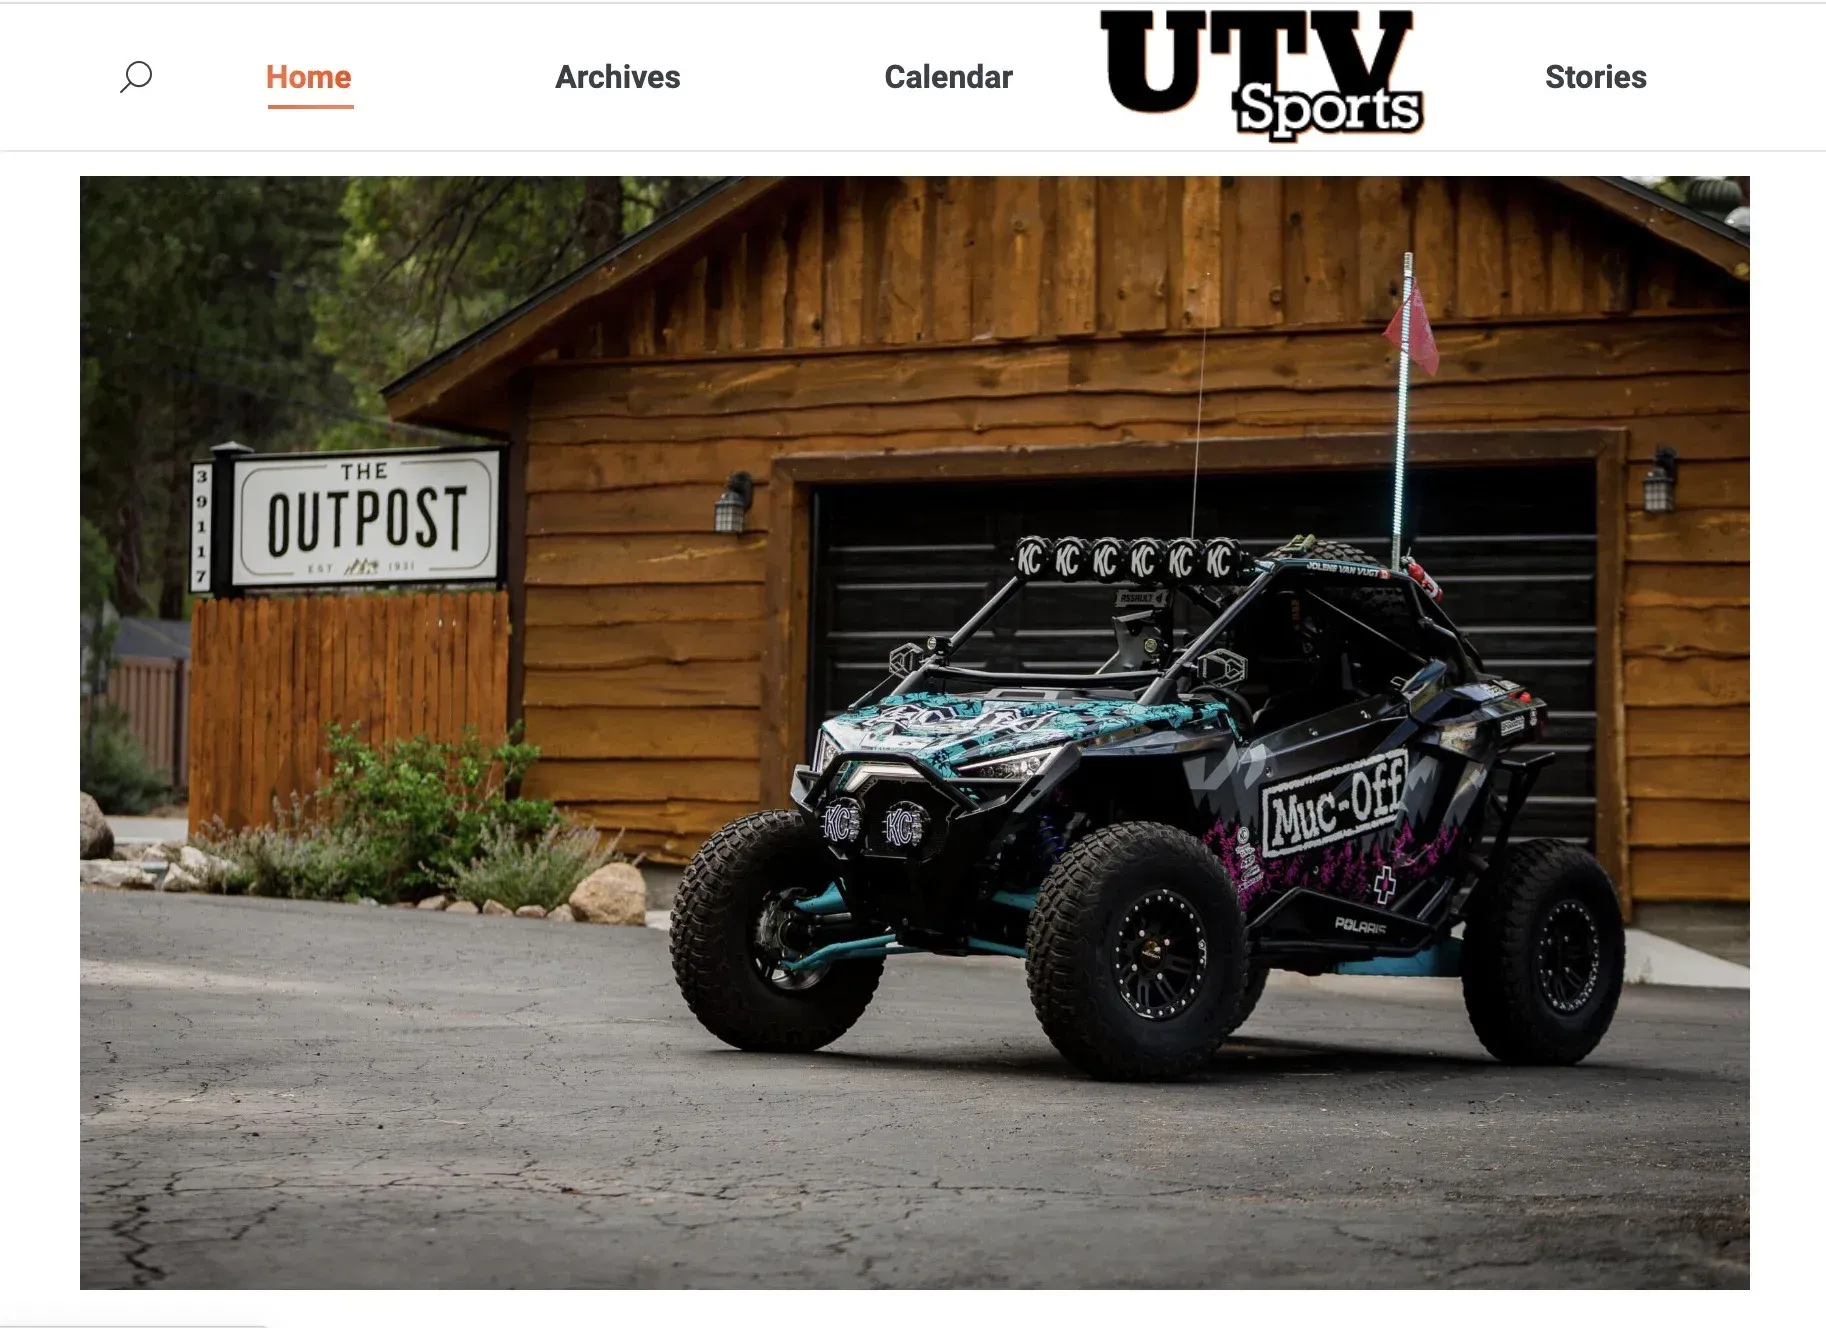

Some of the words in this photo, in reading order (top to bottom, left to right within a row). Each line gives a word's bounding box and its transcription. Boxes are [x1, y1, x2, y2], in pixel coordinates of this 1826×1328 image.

[341, 463, 387, 480] THE
[196, 470, 208, 584] 39117
[268, 486, 467, 558] OUTPOST
[1018, 543, 1041, 576] KC
[1056, 544, 1080, 576] KC
[1093, 545, 1118, 577] KC
[1131, 545, 1155, 577] KC
[1169, 545, 1194, 578] KC
[1207, 545, 1232, 578] KC
[1306, 562, 1338, 573] JOLENE
[1339, 565, 1357, 575] VAN
[1357, 567, 1380, 578] VUGT
[1271, 758, 1404, 847] Muc-Off
[823, 804, 851, 842] KC
[886, 808, 913, 846] KC
[1335, 916, 1387, 934] POLARIS
